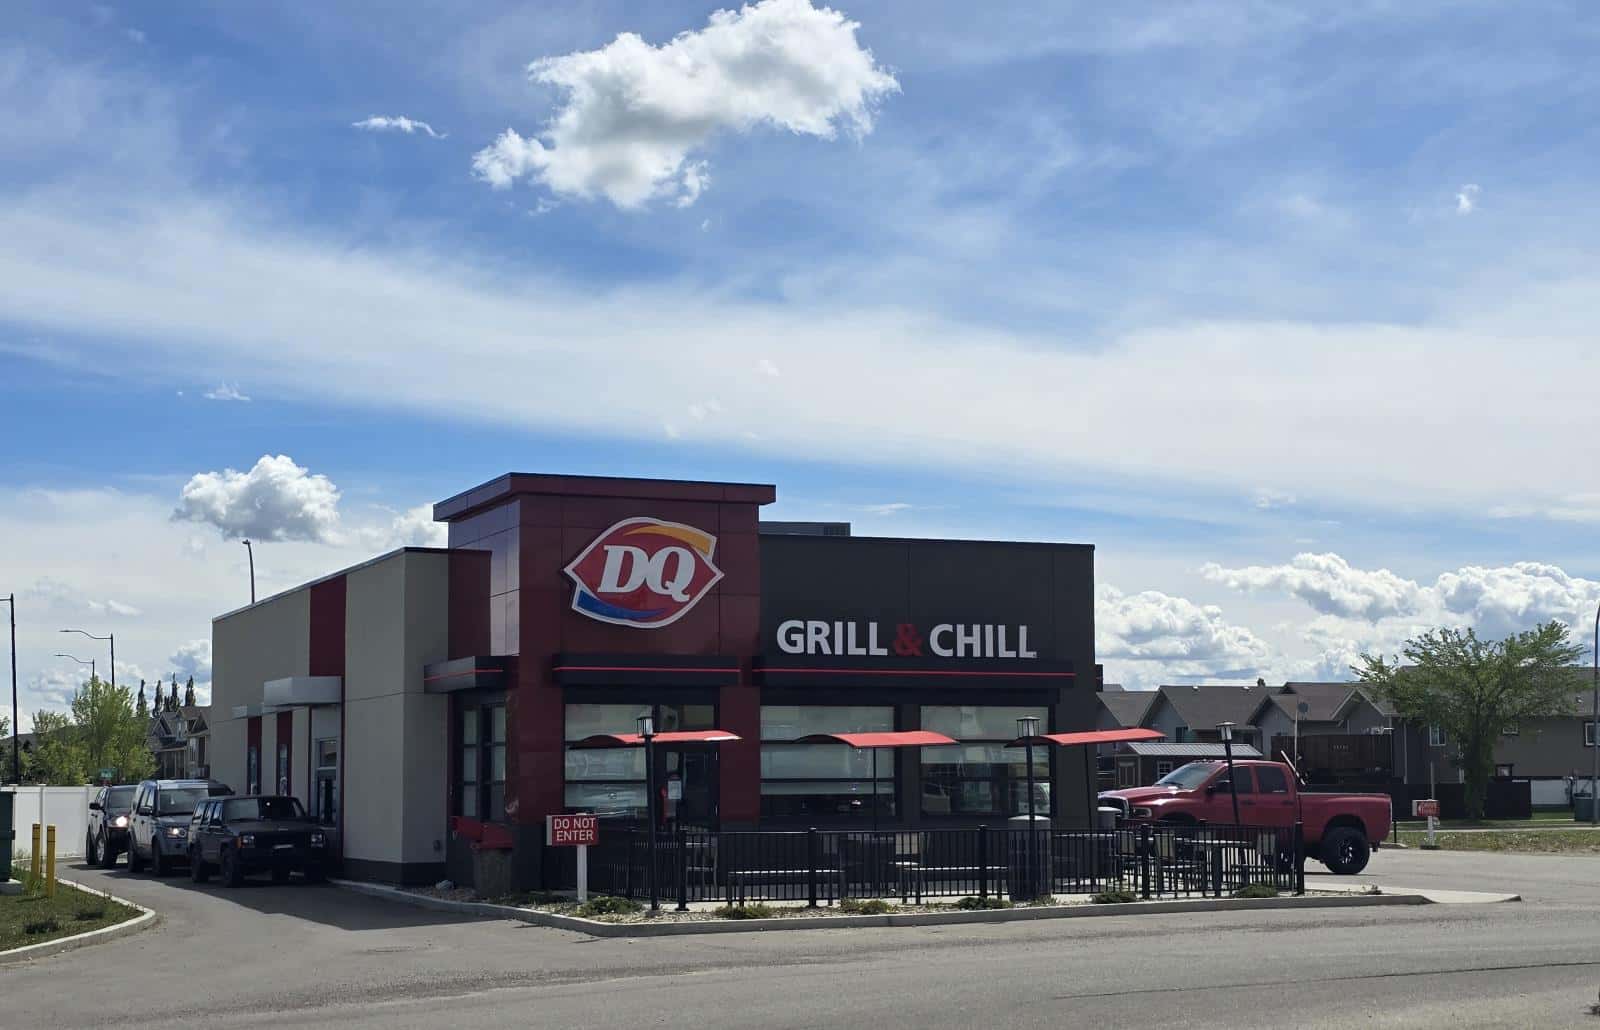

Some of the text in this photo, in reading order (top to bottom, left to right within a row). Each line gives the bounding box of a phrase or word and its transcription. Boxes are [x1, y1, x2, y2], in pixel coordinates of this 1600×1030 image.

[597, 545, 695, 602] DQ
[776, 619, 1038, 658] GRILL & CHILL
[554, 817, 596, 830] DO NOT
[556, 830, 594, 841] ENTER
